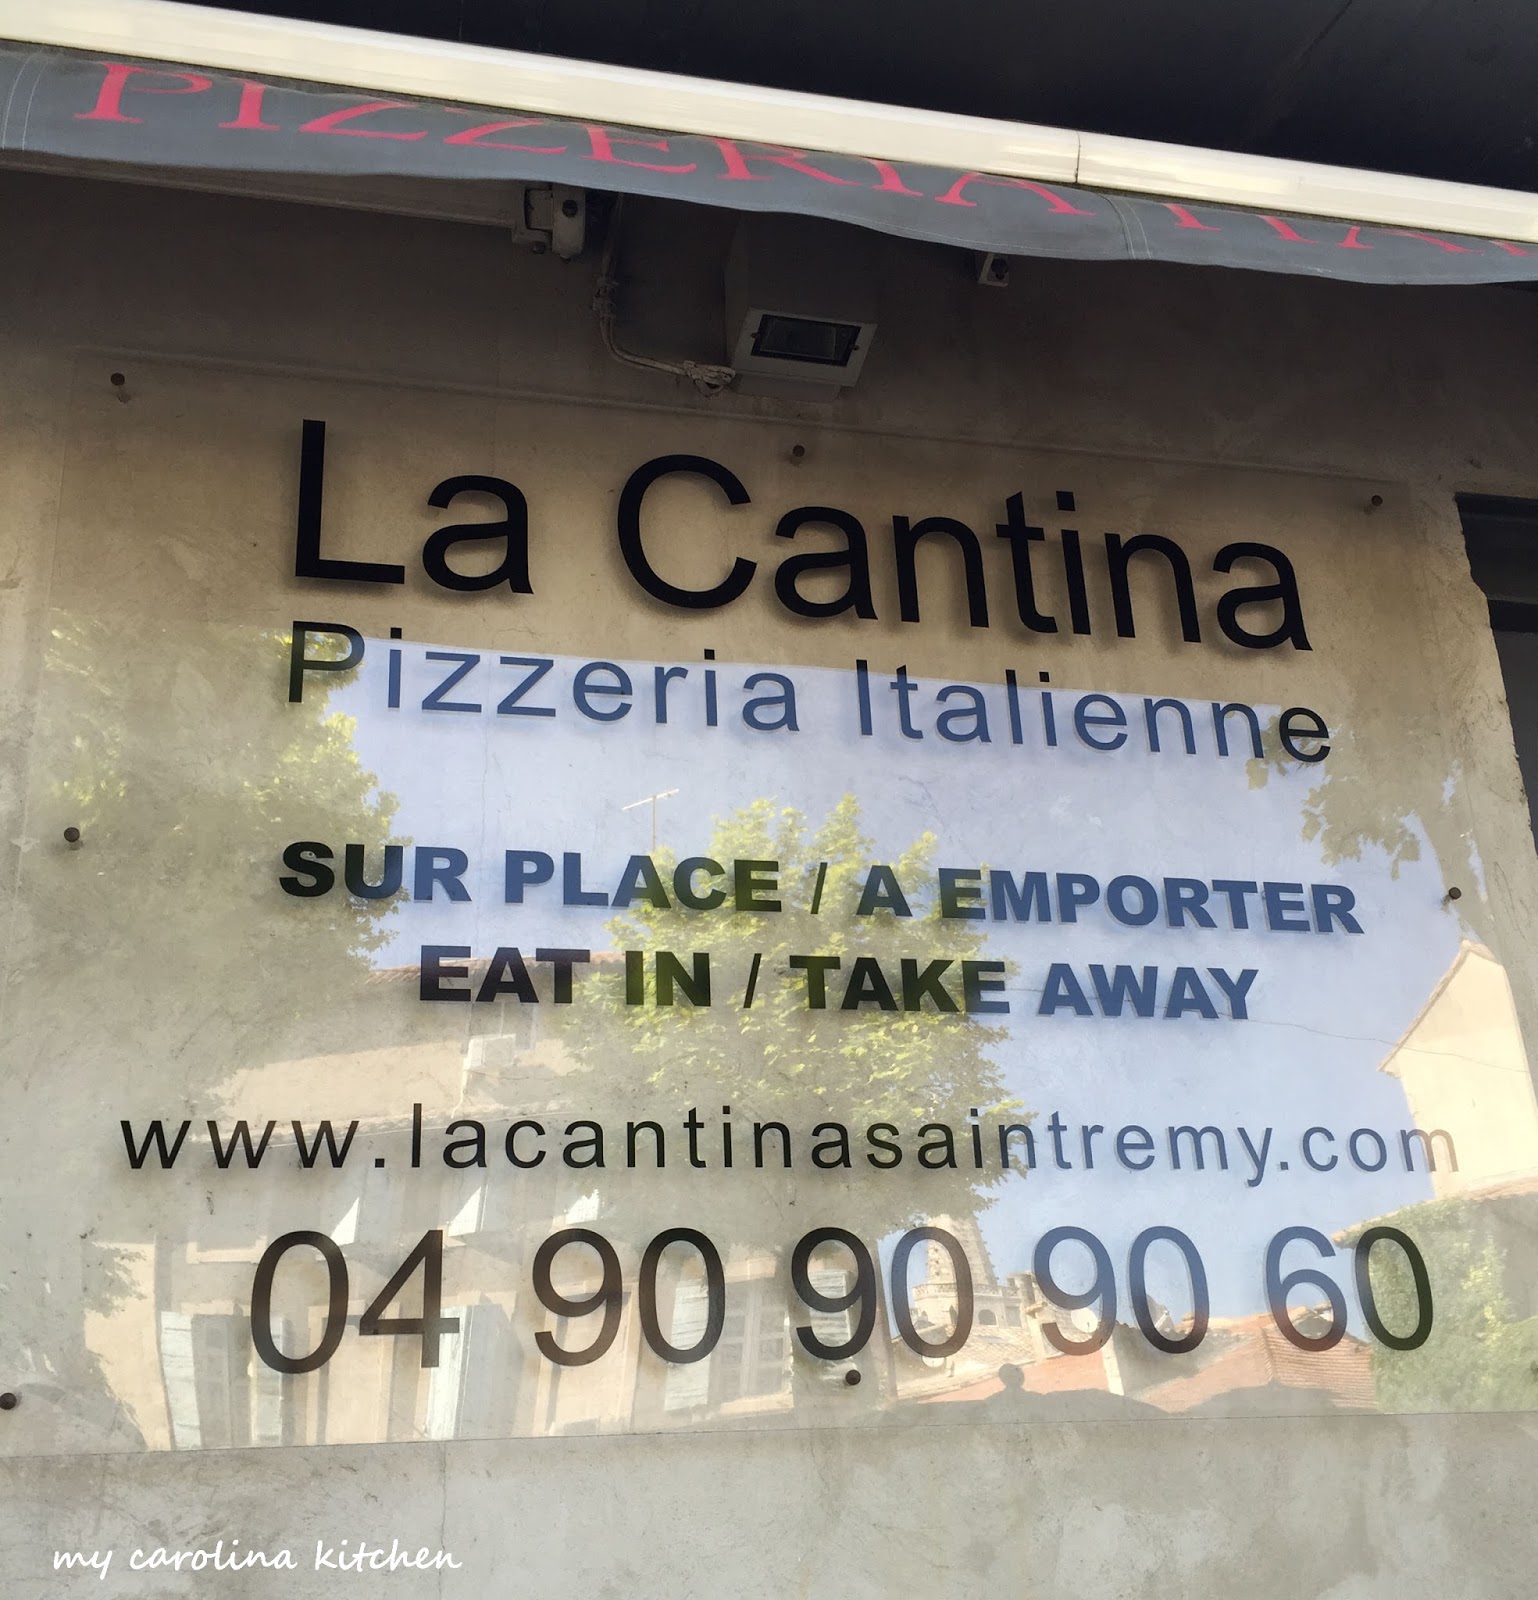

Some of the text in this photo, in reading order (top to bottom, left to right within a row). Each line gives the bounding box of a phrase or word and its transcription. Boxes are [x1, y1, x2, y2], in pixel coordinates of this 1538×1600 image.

[295, 419, 1313, 652] La Cantina
[289, 620, 1331, 763] Pizzeria Italienne
[279, 841, 1365, 934] SUR PLACE / A EMPORTER
[419, 945, 1259, 1019] EAT IN / TAKE AWAY
[120, 1103, 1459, 1187] www.lacantinasaintremy.com
[250, 1226, 1434, 1374] 04 90 90 90 60
